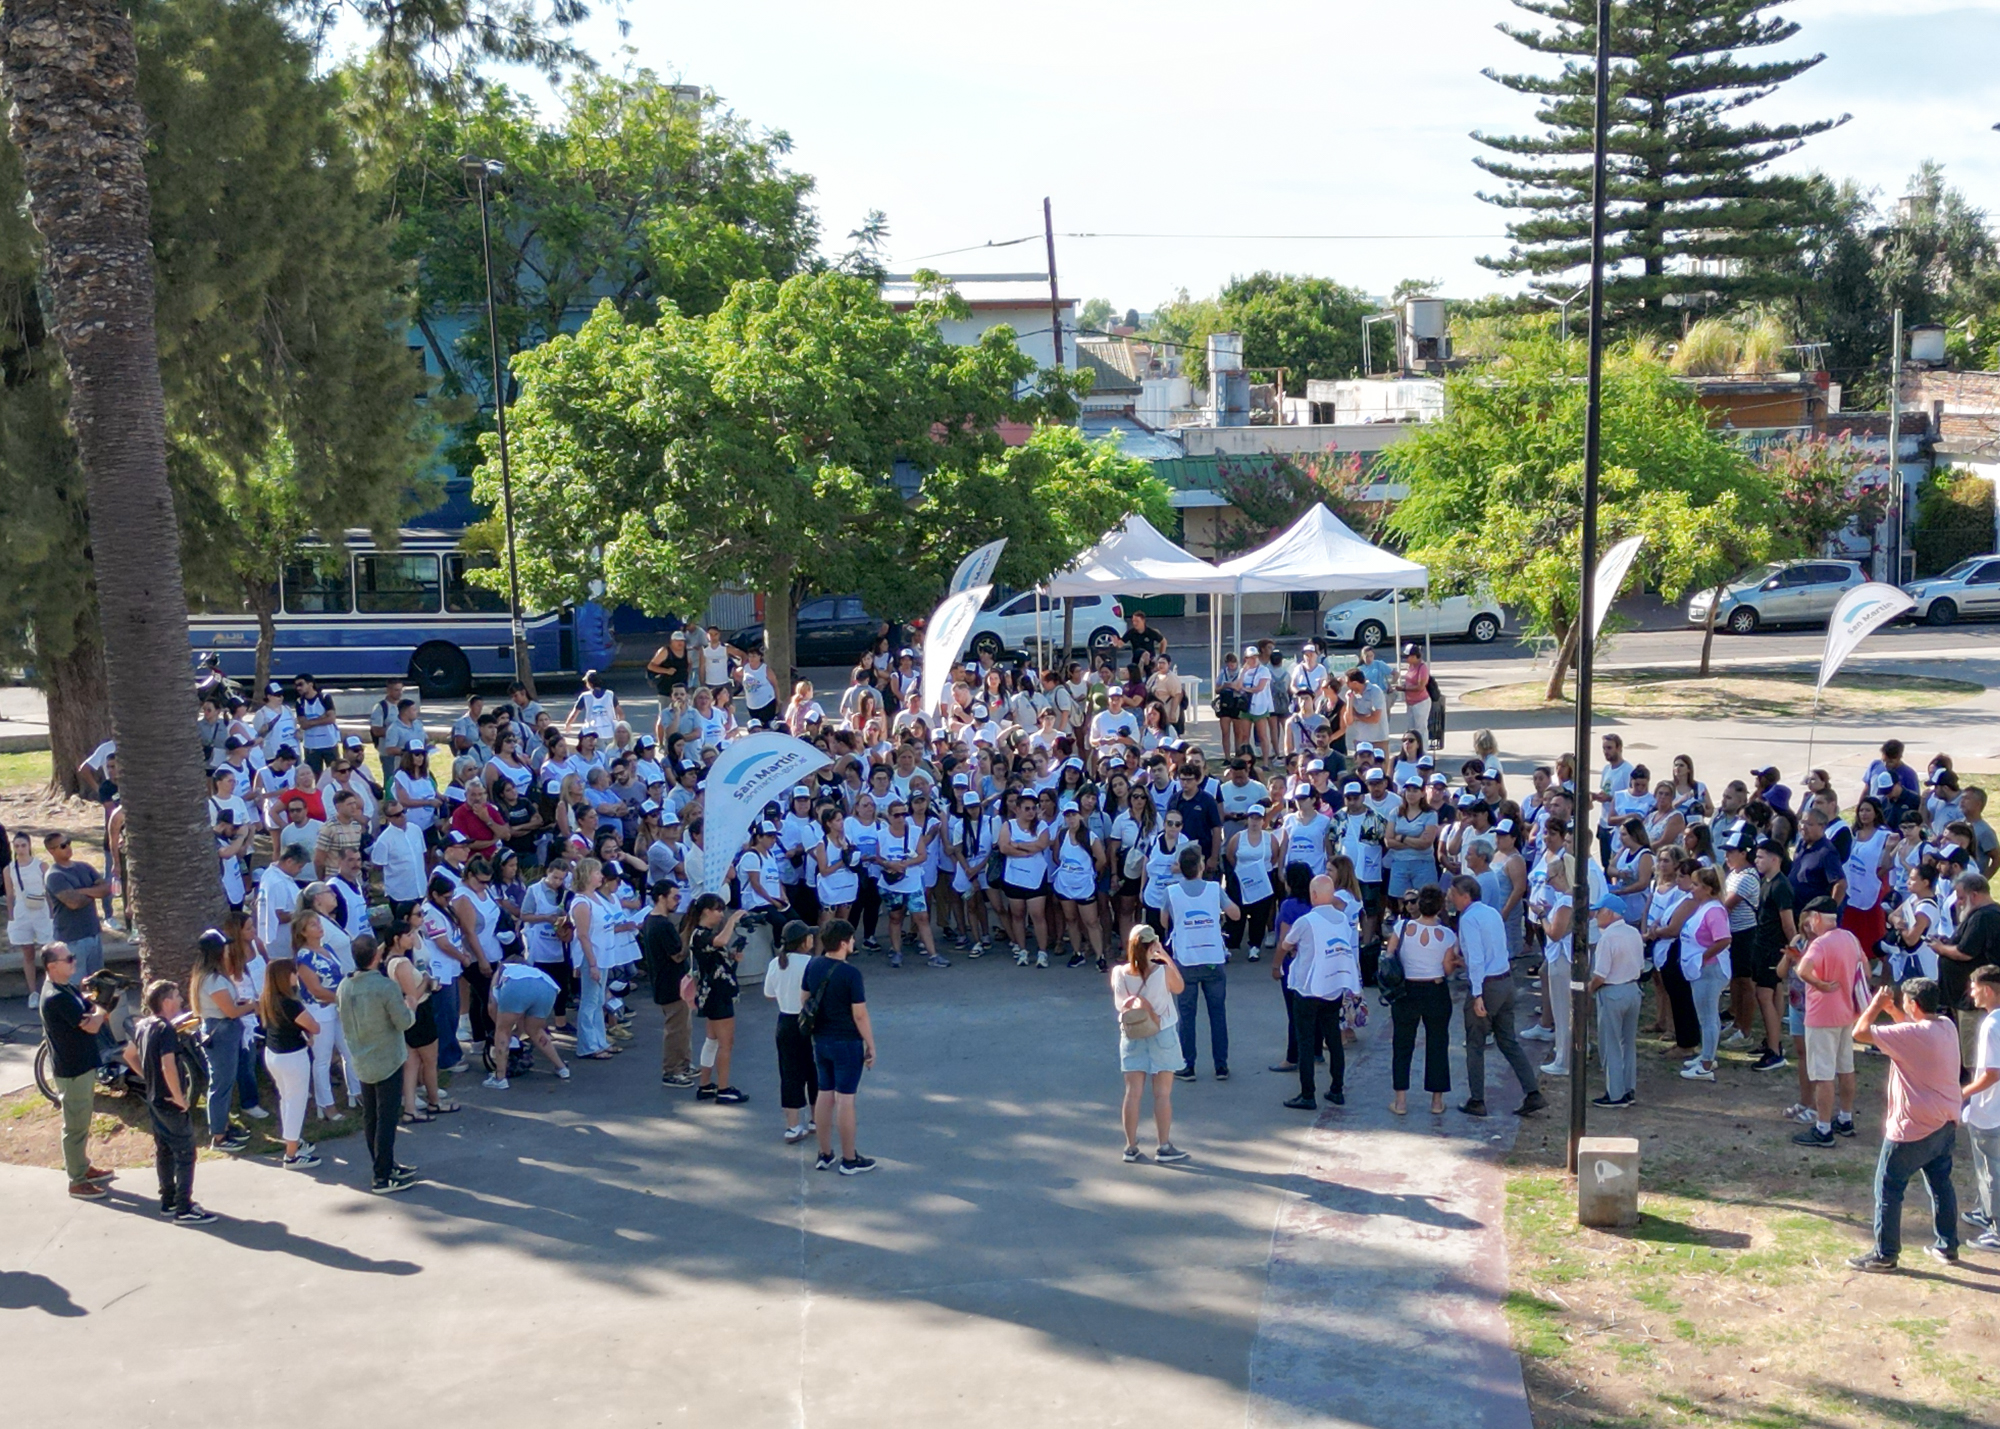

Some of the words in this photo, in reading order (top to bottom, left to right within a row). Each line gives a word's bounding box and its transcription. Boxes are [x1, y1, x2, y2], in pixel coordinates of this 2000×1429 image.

[1847, 621, 1863, 634] San
[1862, 602, 1894, 622] Martin
[733, 779, 757, 800] San
[754, 752, 799, 780] Martin
